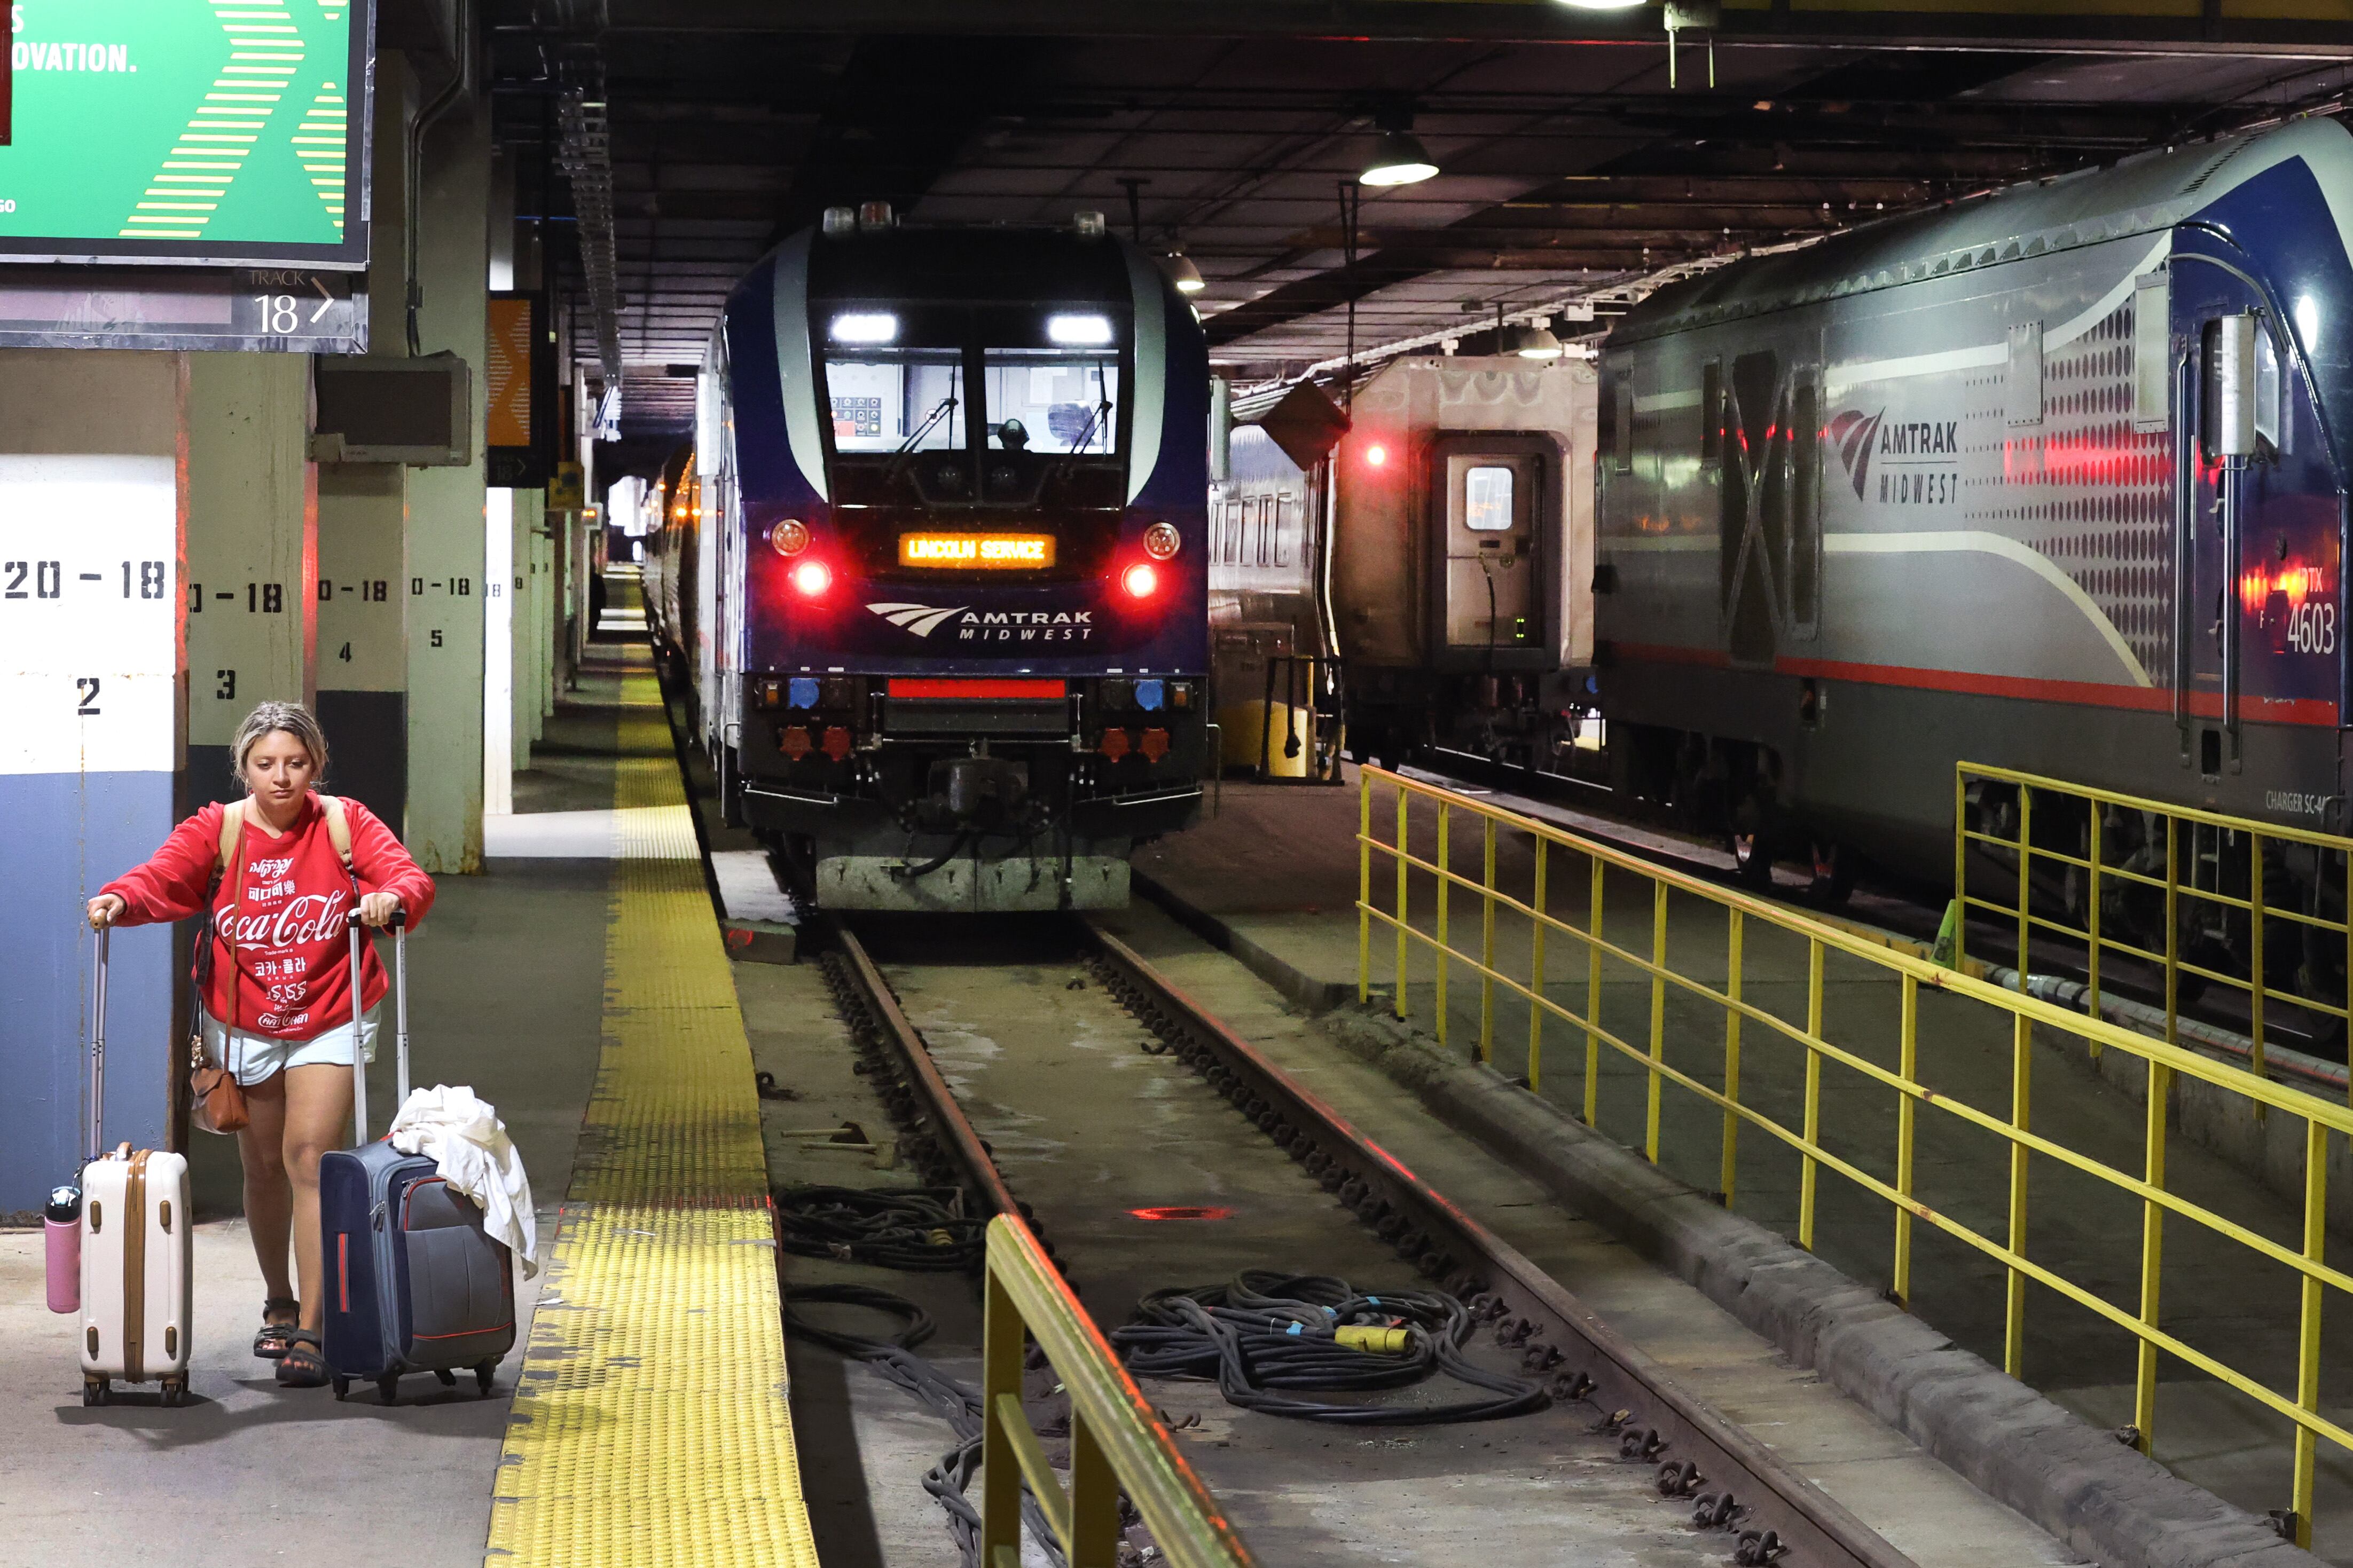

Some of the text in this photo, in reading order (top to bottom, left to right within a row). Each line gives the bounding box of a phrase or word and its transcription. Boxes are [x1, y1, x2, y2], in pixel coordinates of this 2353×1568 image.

[12, 42, 137, 73] OVATION.
[248, 270, 305, 286] TRACK
[254, 294, 298, 333] 18
[1880, 421, 1957, 454] AMTRAK
[1880, 474, 1957, 504] MIDWEST
[908, 540, 1045, 559] LINCOLN SERVICE
[961, 611, 1092, 624] AMTRAK
[2287, 602, 2335, 655] 4603
[430, 629, 442, 647] 5
[959, 628, 1091, 640] MIDWEST
[339, 642, 351, 663] 4
[76, 677, 100, 715] 2
[217, 669, 236, 699] 3
[2266, 791, 2303, 813] CHARGER
